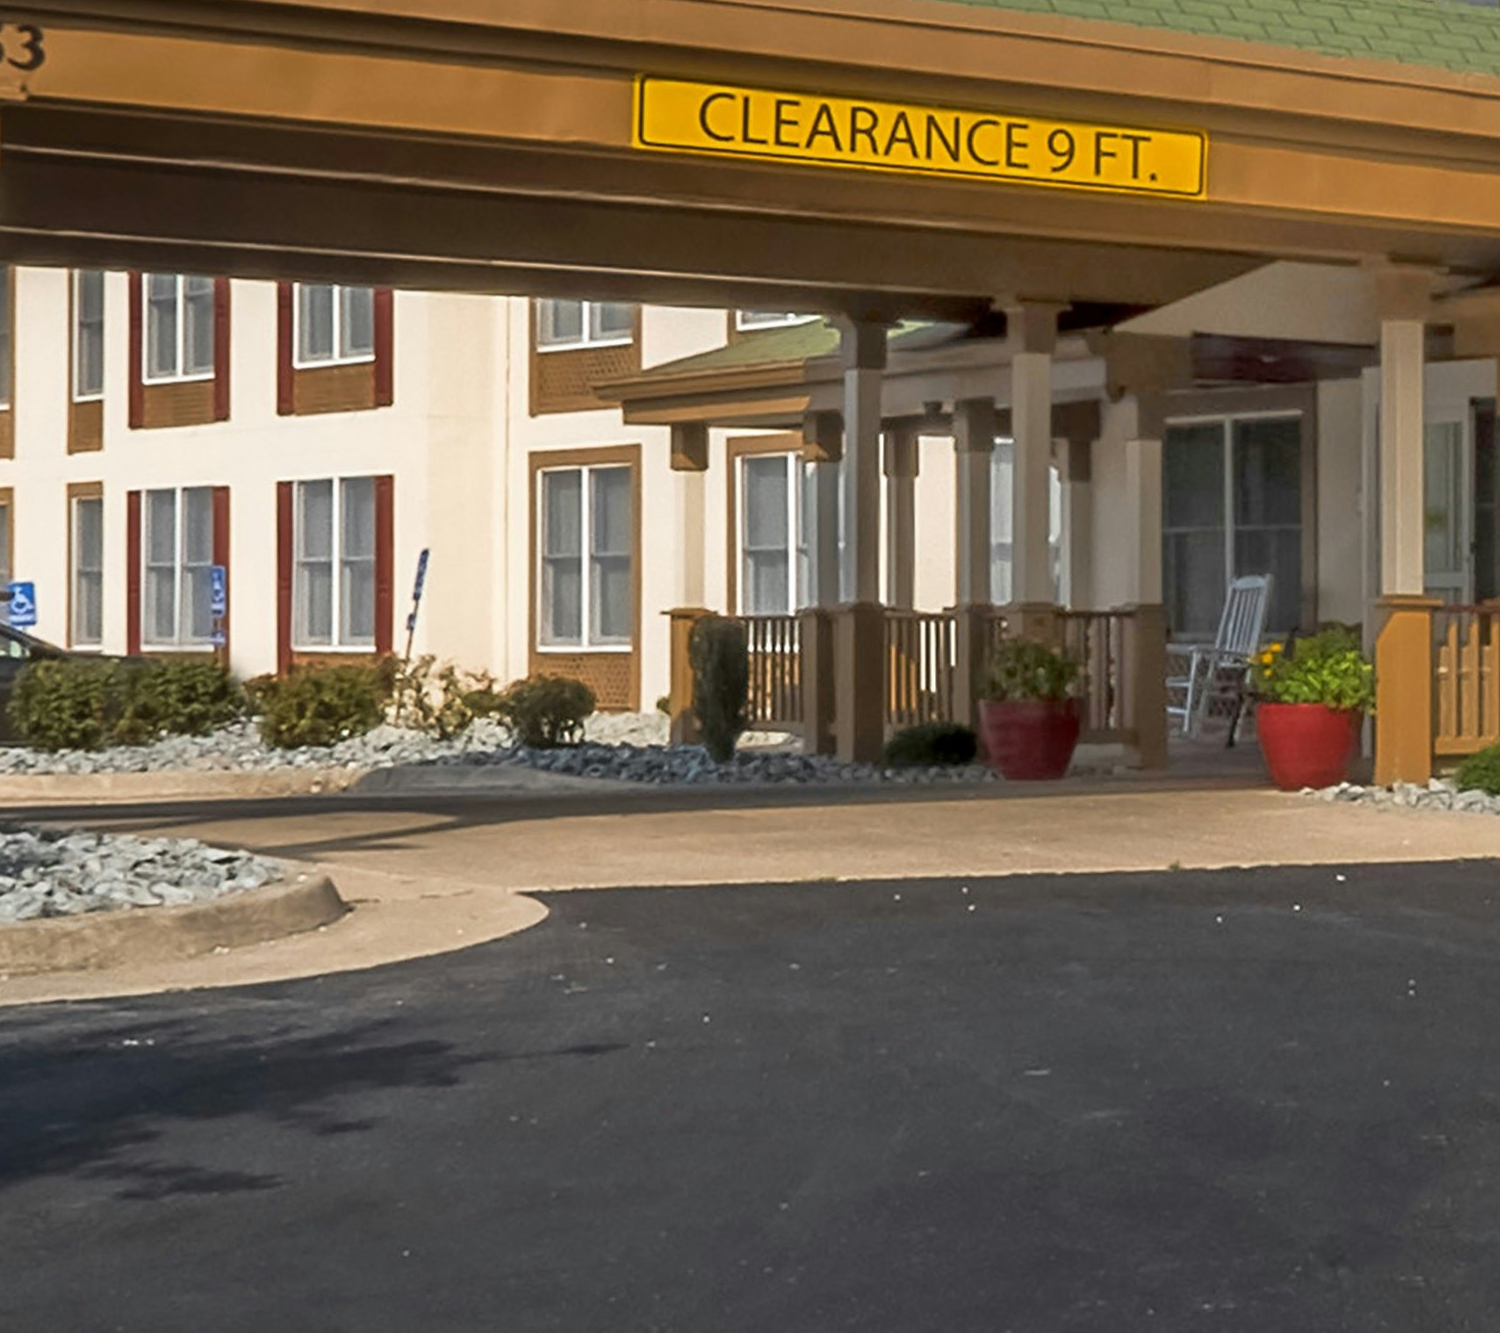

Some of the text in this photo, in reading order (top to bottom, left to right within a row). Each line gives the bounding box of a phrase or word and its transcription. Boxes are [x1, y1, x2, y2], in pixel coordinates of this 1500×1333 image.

[699, 92, 1158, 182] CLEARANCE 9 FT.
